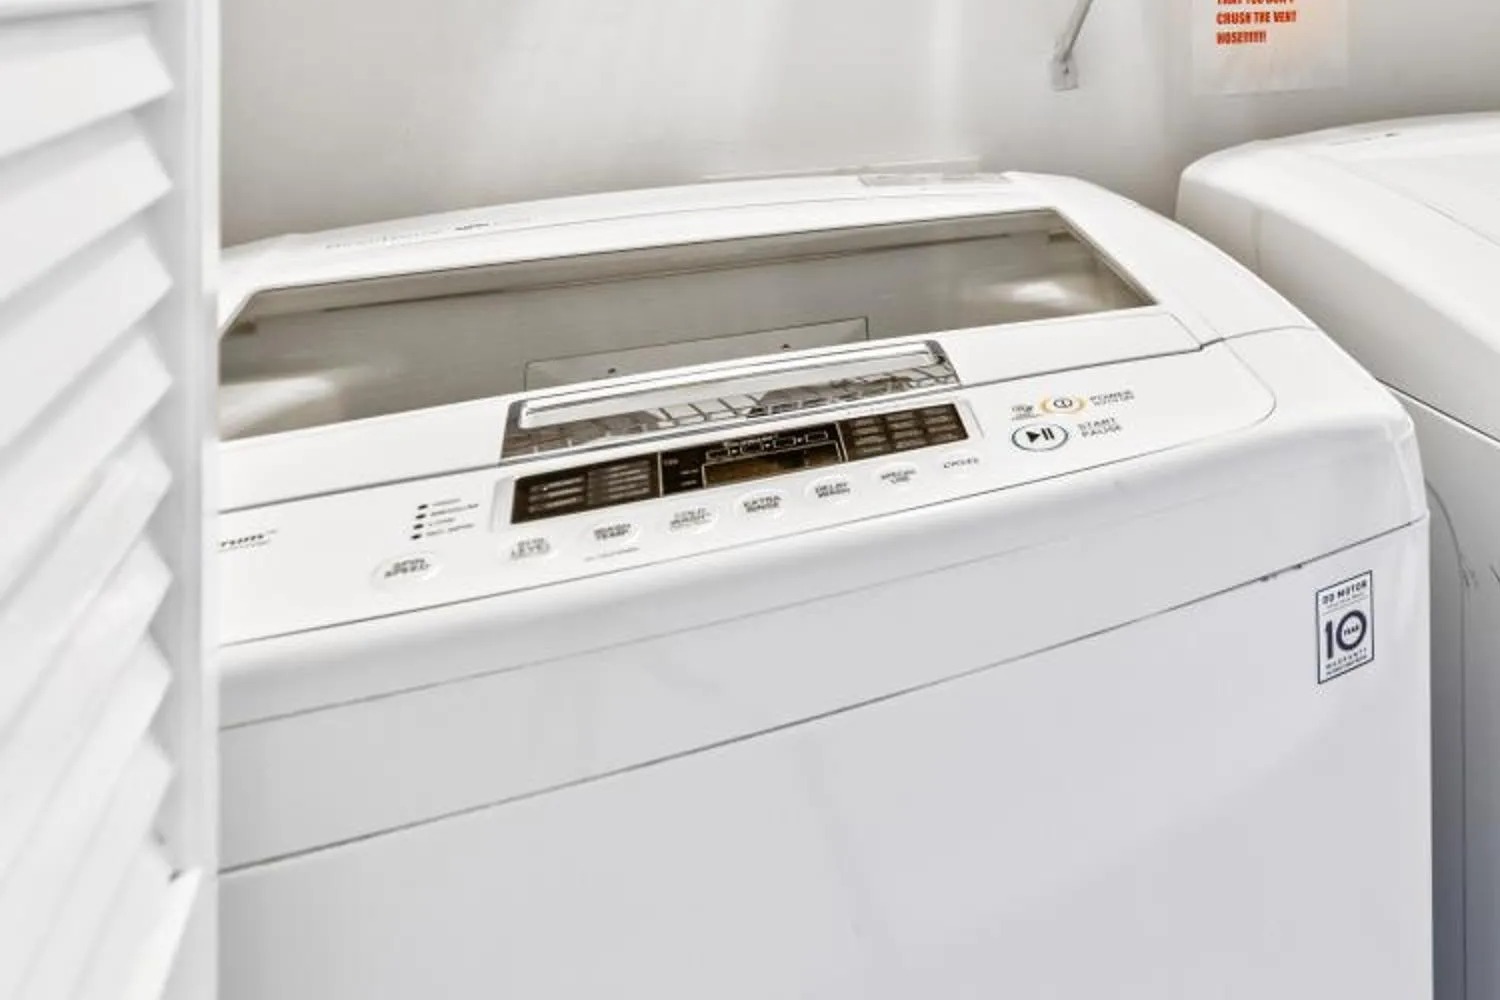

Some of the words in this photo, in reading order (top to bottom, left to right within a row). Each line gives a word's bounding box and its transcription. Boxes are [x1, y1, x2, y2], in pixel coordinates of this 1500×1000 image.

[1216, 12, 1252, 25] CRUSH
[1254, 12, 1270, 24] THE
[1273, 10, 1297, 23] VENT
[1078, 417, 1116, 429] START
[1325, 610, 1367, 660] 10
